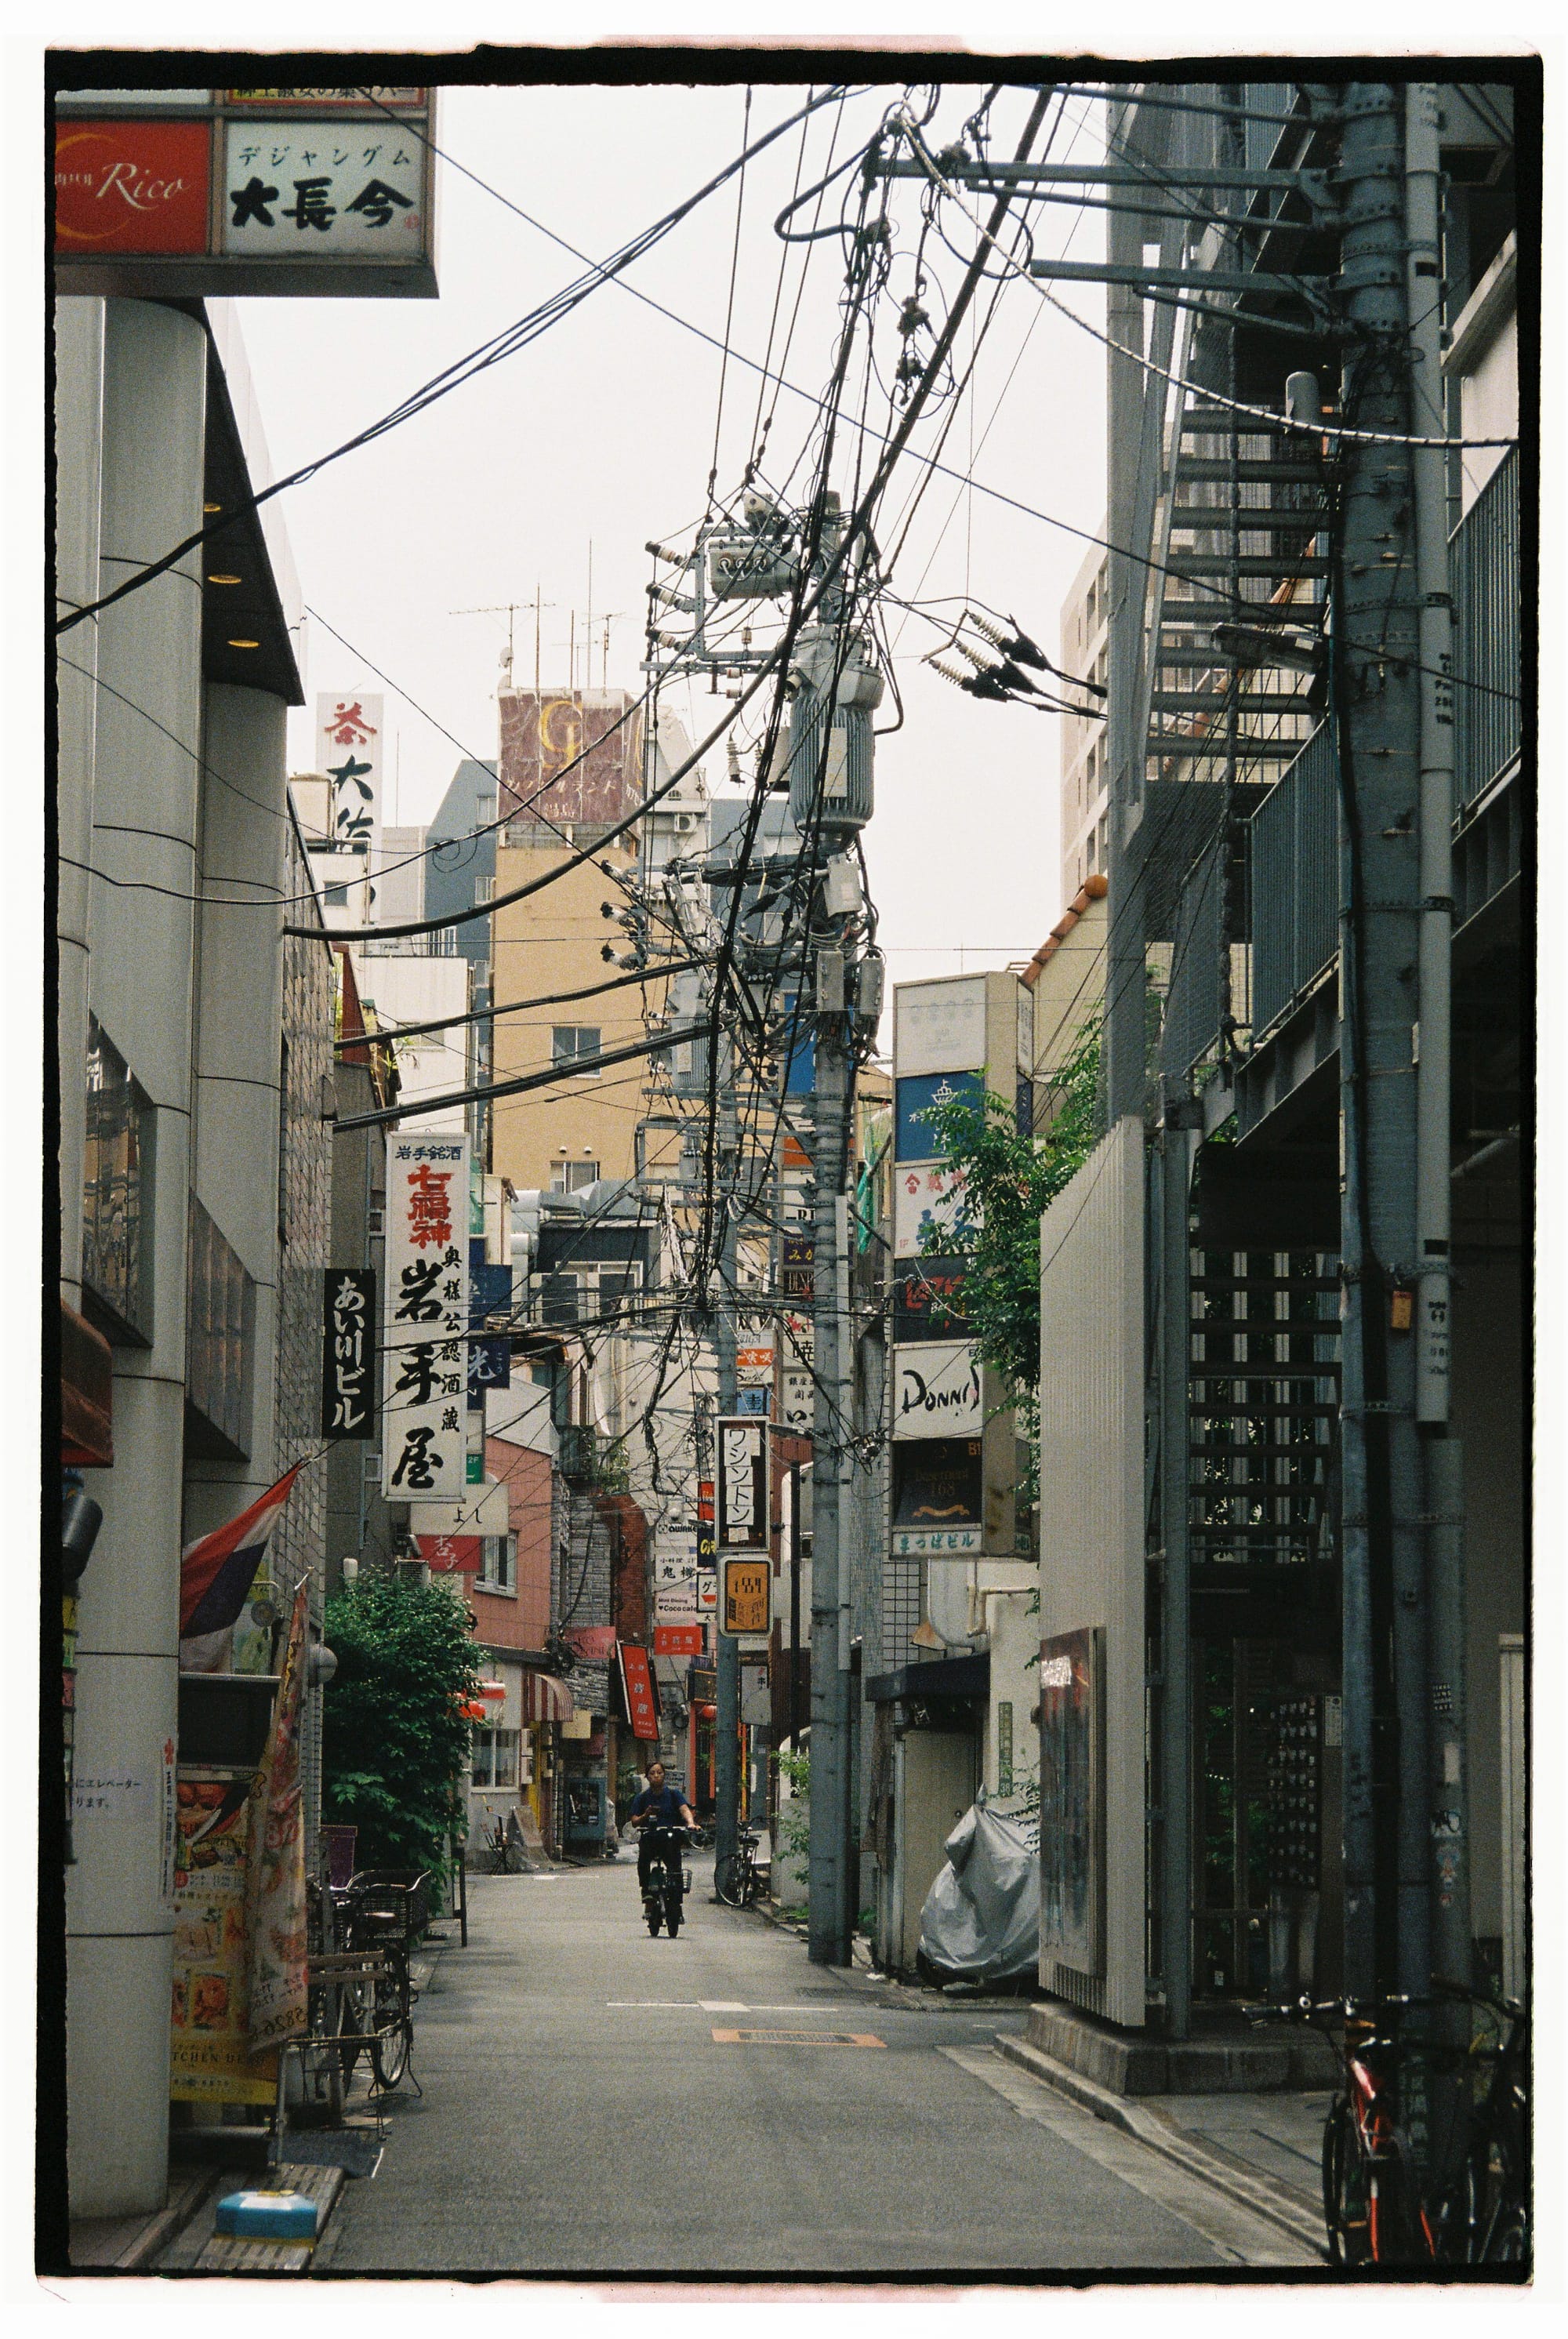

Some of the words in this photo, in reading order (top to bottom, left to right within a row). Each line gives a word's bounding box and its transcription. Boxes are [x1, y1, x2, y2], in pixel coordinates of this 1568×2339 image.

[239, 146, 412, 168] デジャングム
[230, 176, 414, 232] 大長今
[325, 702, 376, 746] 茶
[395, 1146, 463, 1160] 岩手銘酒
[407, 1164, 454, 1249] 七福神
[332, 1276, 366, 1430] あい川ビル
[391, 1258, 444, 1489] 岩手屋
[441, 1245, 463, 1433] 奥様公認酒蔵
[729, 1429, 750, 1523] ワシントン
